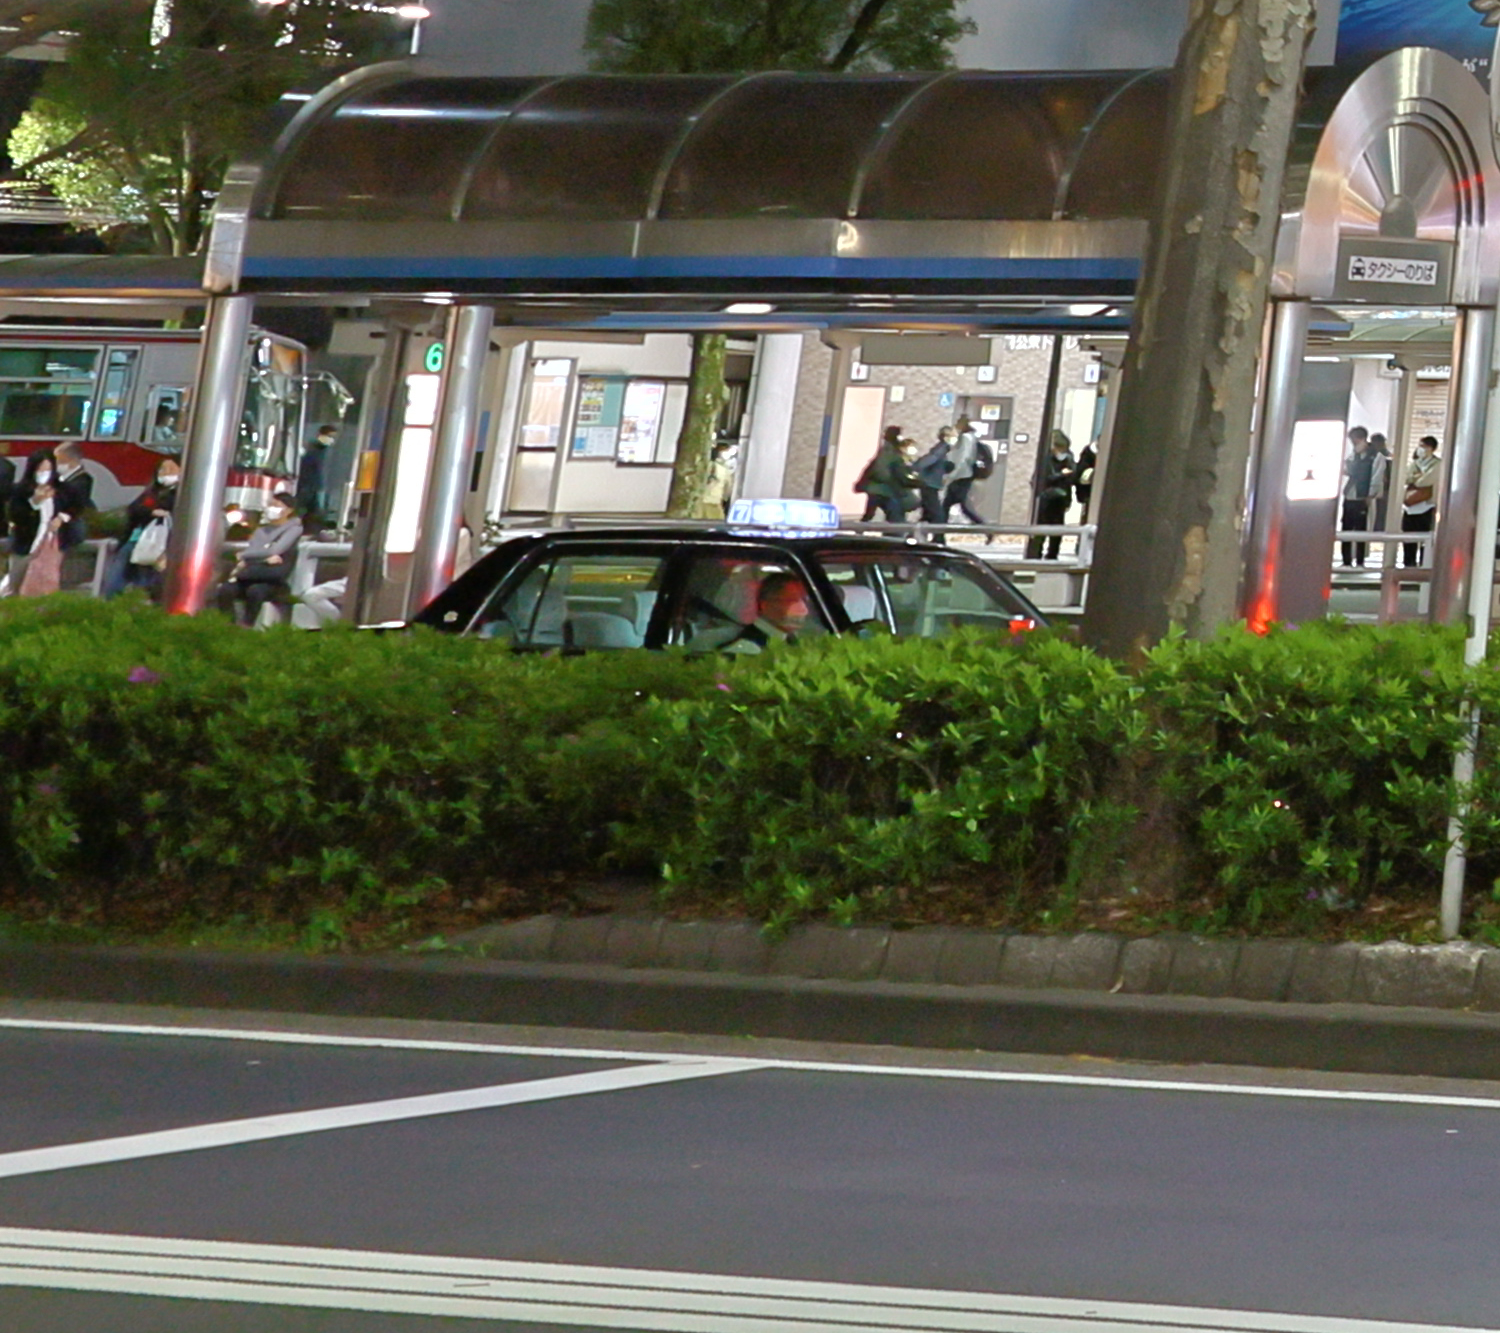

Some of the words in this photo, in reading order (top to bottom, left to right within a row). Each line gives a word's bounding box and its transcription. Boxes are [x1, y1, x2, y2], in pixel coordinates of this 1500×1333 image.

[1367, 261, 1435, 282] タクシーのりば
[425, 342, 444, 372] 6
